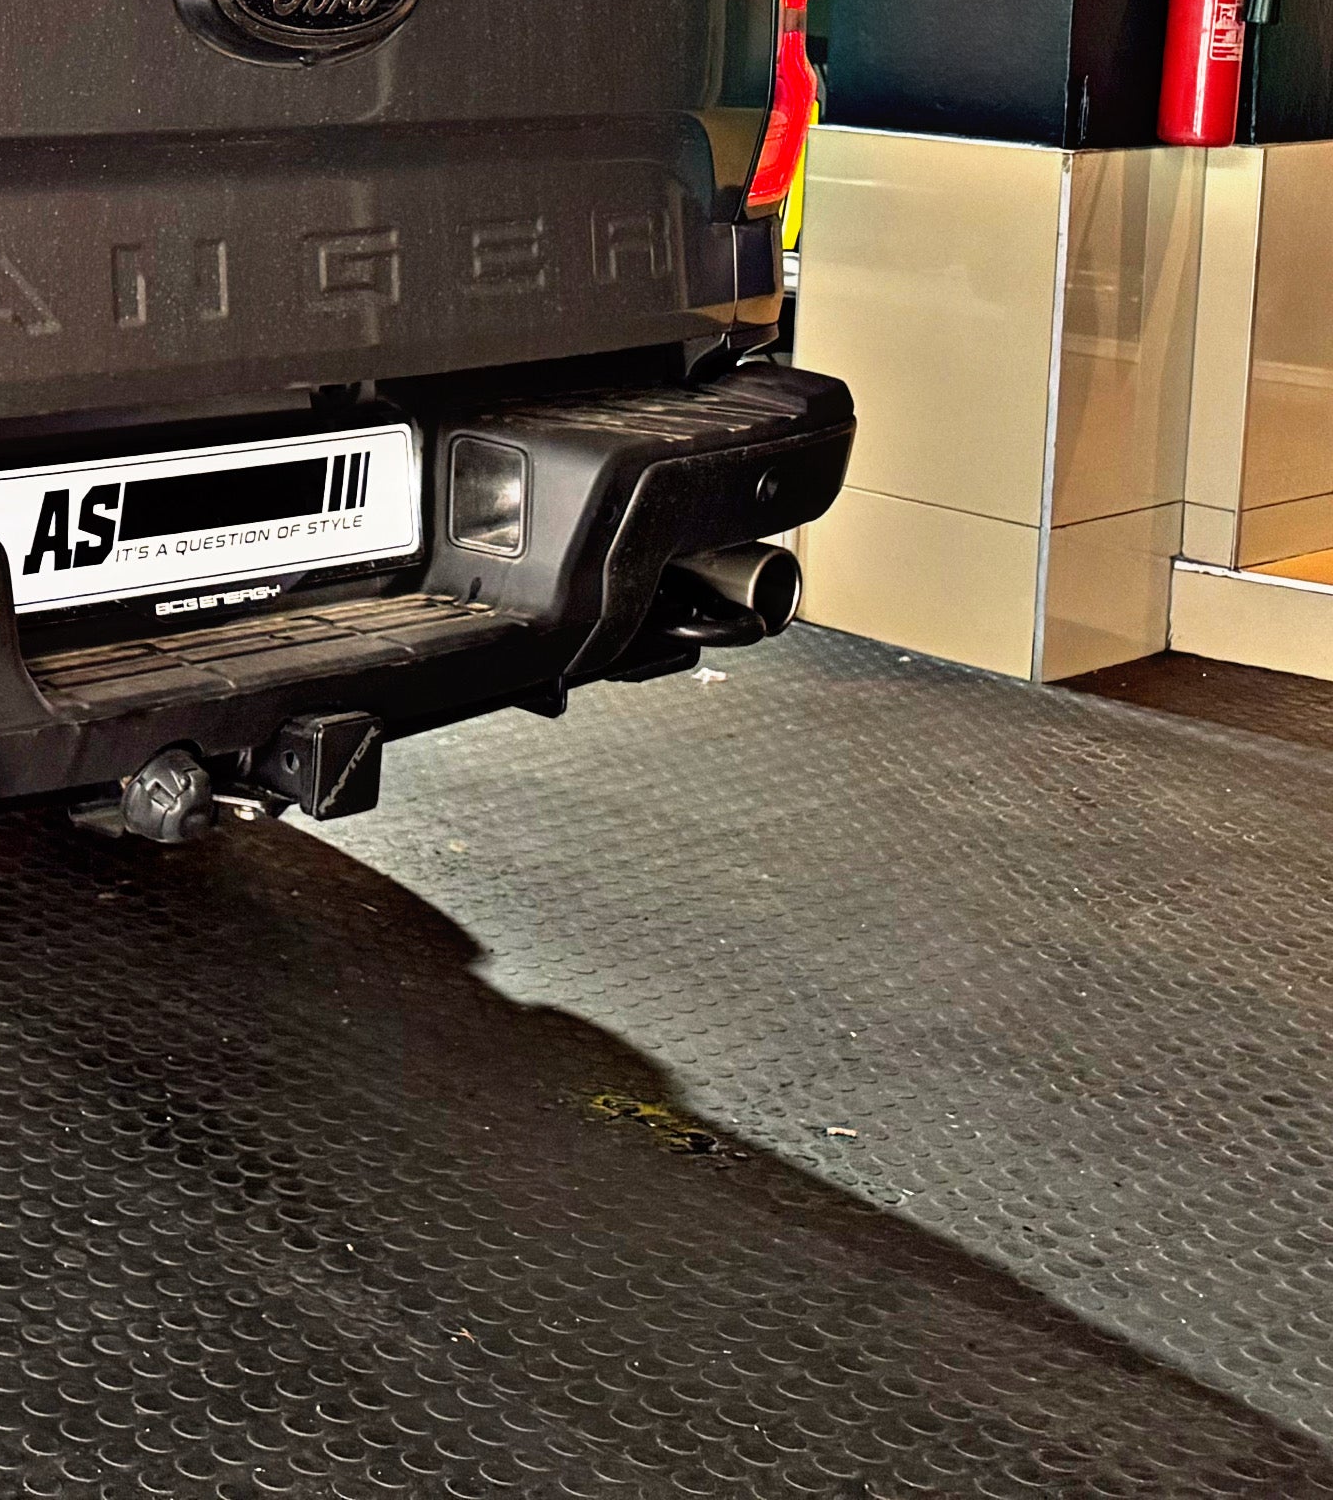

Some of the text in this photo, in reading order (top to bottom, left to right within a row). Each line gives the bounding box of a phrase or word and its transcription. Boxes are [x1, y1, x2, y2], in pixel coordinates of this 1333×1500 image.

[22, 482, 122, 576] AS
[115, 514, 364, 563] IT'S A QUESTION OF STYLE
